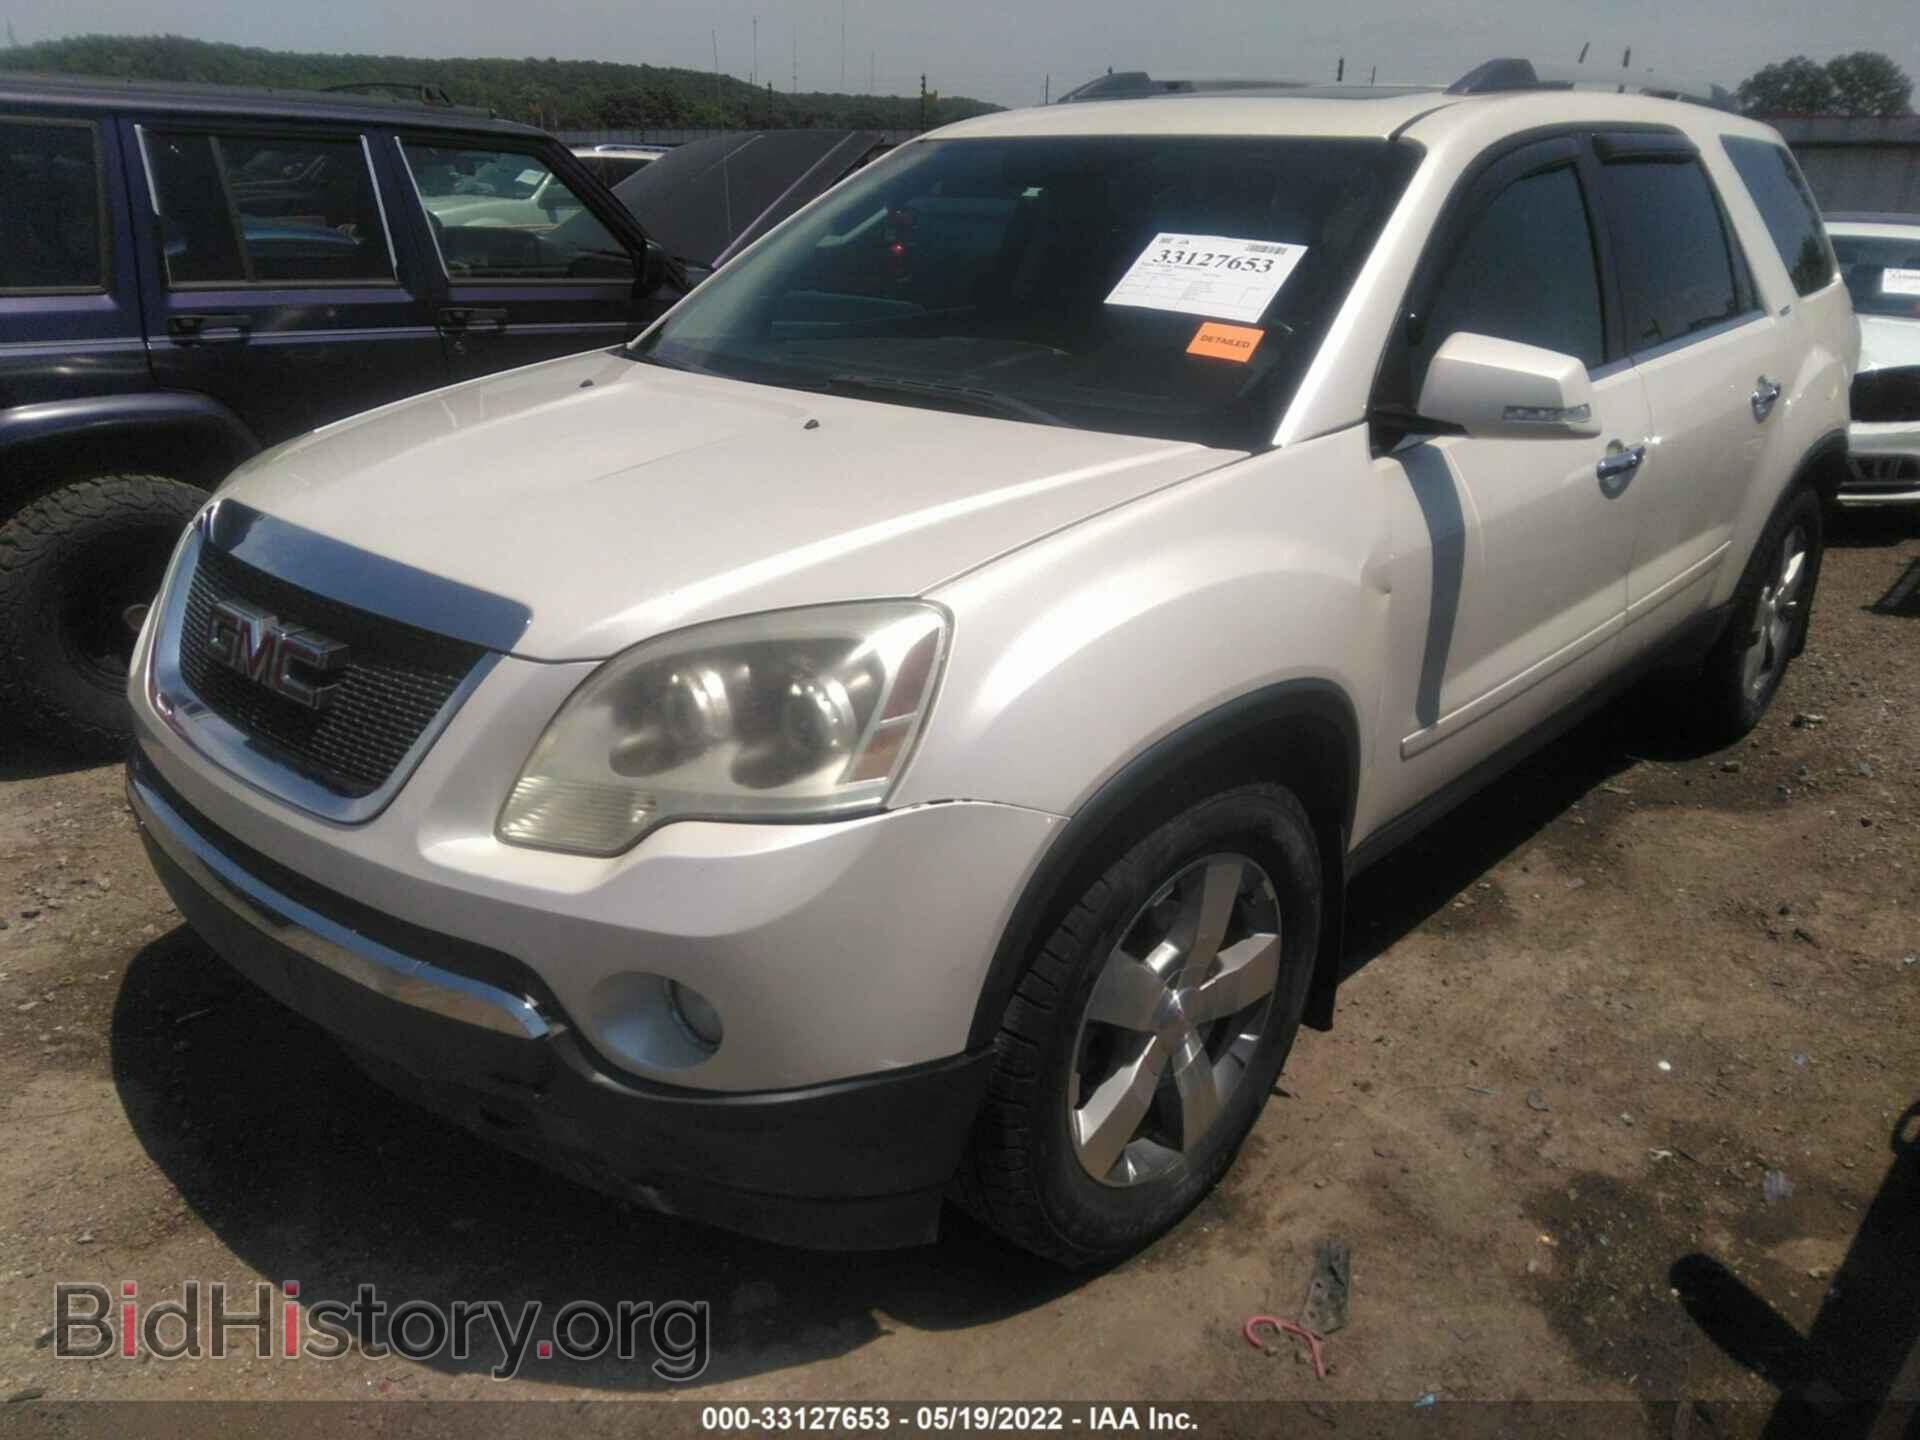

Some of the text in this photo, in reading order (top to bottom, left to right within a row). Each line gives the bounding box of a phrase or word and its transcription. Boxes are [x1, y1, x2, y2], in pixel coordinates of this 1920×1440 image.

[1153, 249, 1274, 272] 33127653
[1200, 335, 1250, 348] DETAILED
[208, 599, 349, 710] GMC
